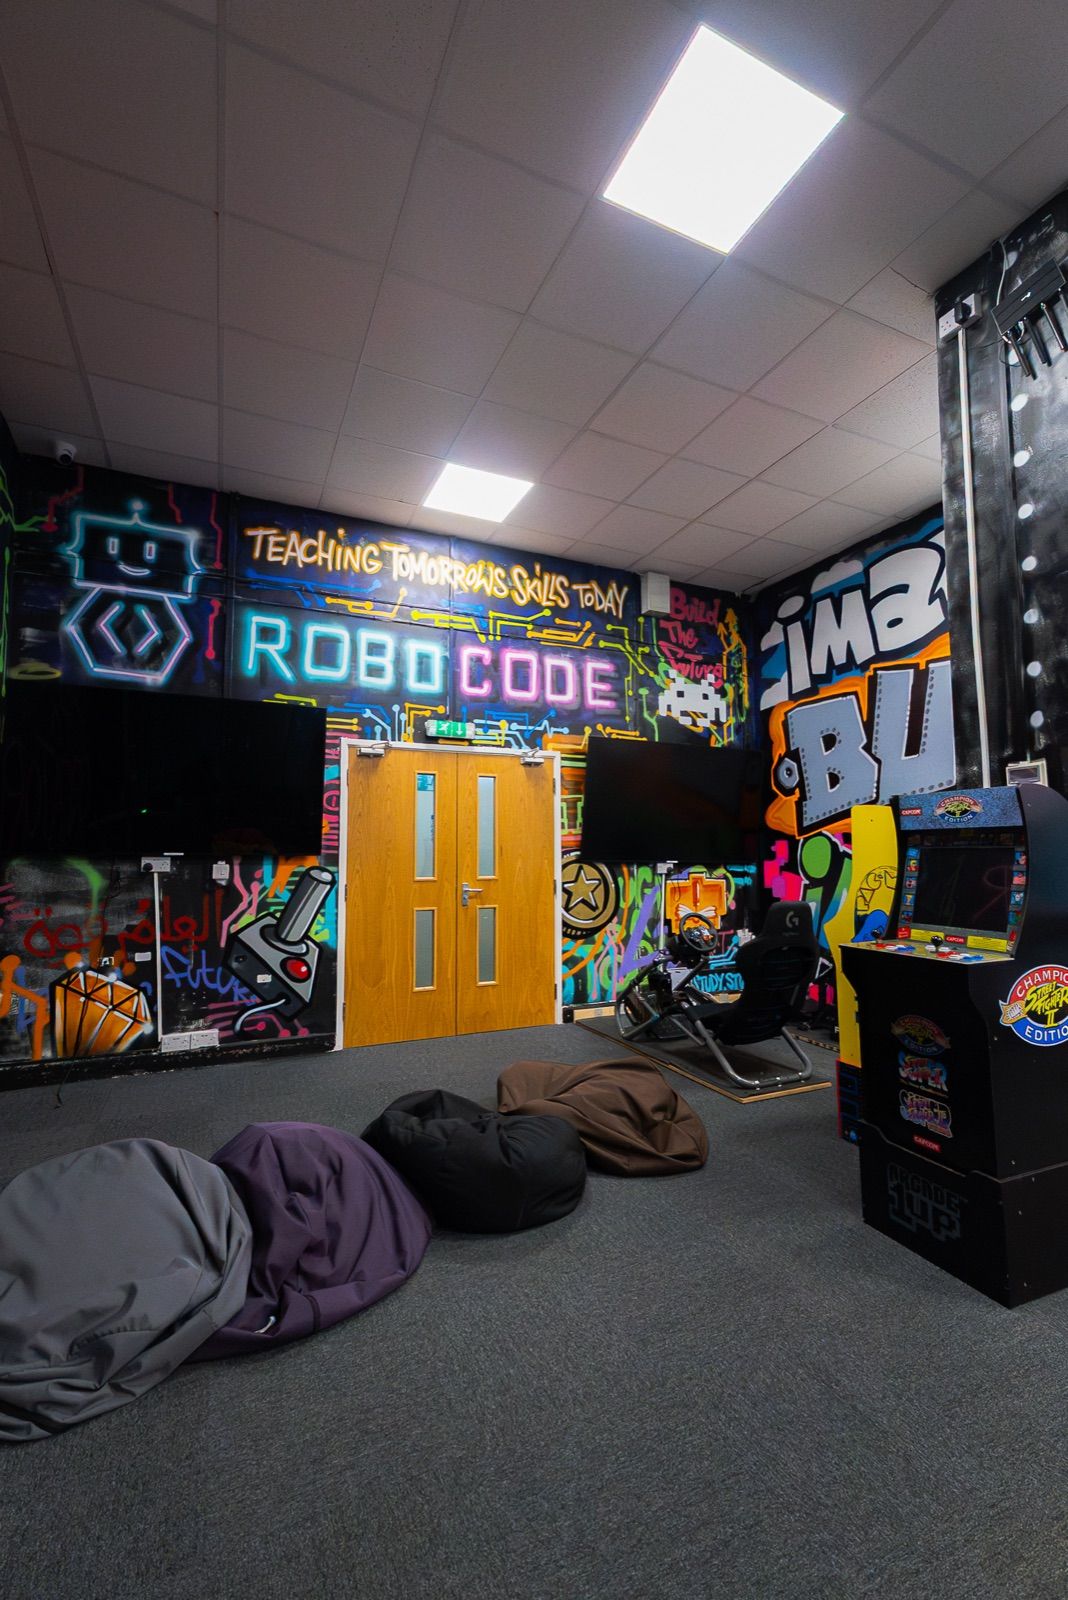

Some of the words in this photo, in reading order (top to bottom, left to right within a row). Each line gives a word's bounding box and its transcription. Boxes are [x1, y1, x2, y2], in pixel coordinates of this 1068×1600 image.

[243, 608, 446, 696] ROBO
[458, 644, 619, 710] CODE
[658, 618, 699, 649] The
